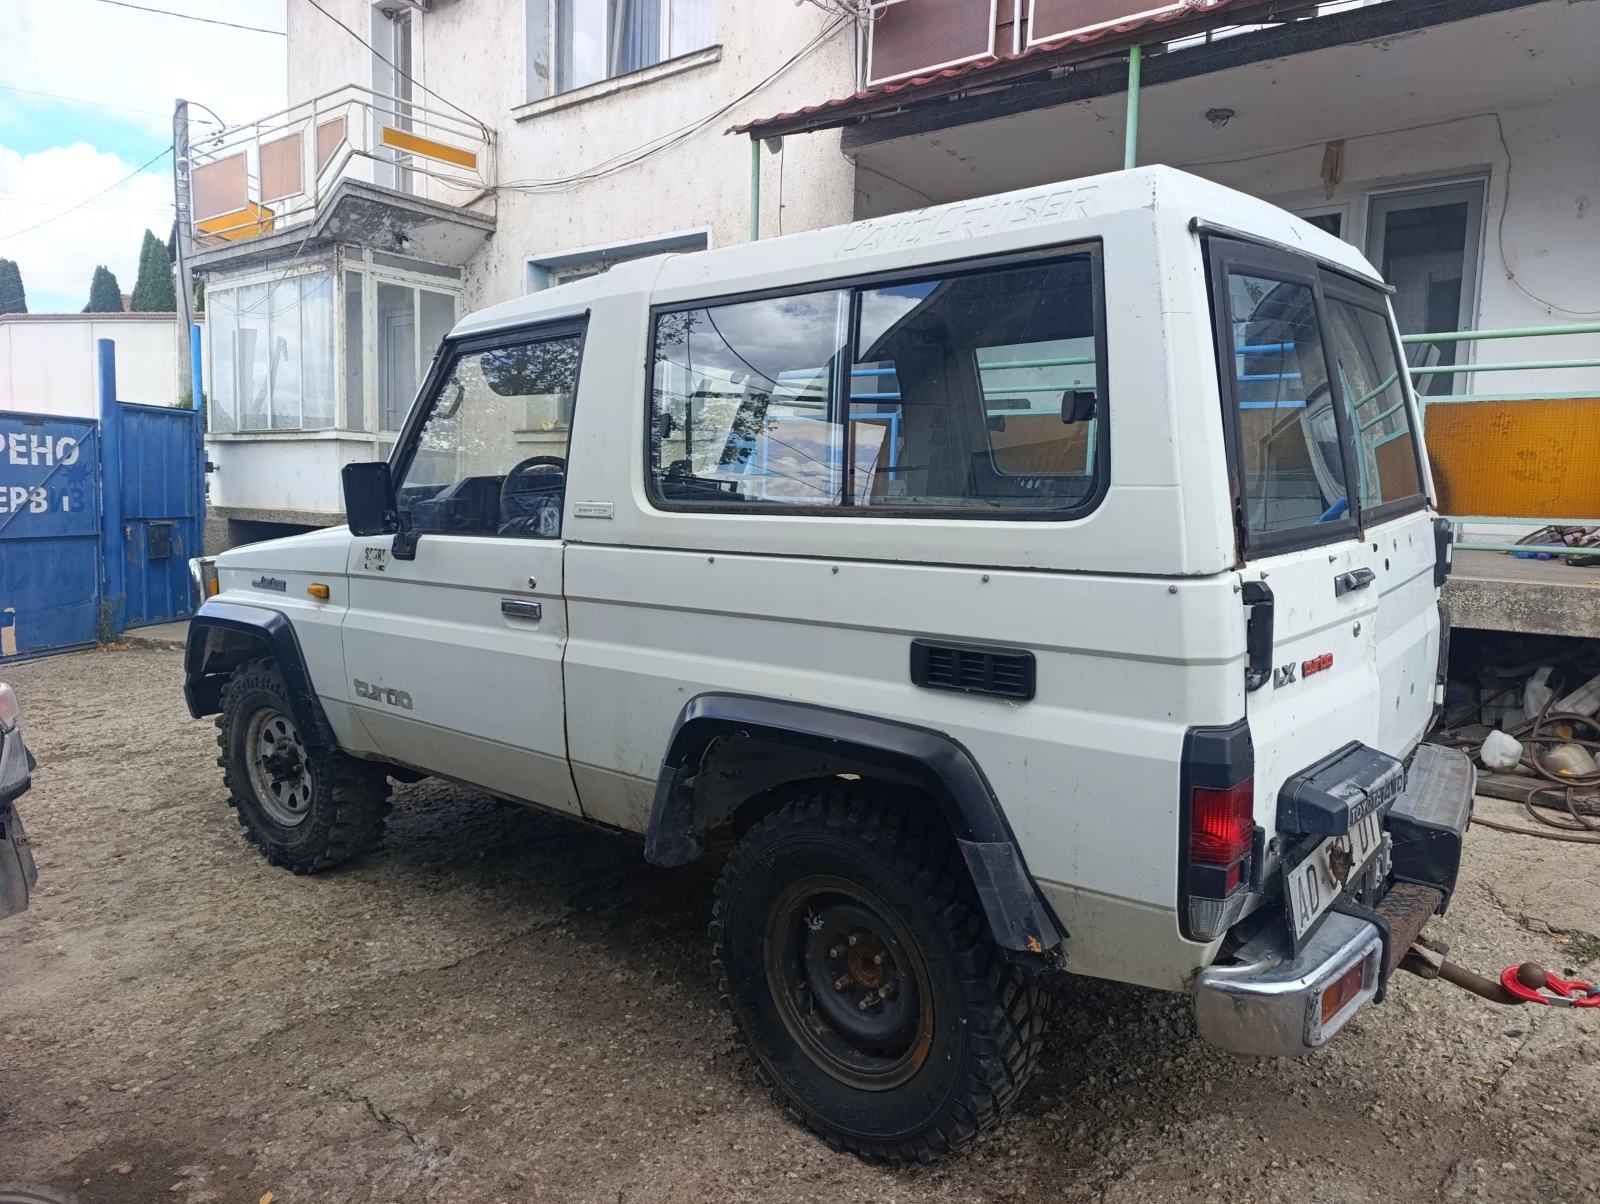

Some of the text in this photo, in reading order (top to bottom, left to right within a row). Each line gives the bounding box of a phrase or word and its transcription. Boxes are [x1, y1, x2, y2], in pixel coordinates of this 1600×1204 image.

[928, 185, 1100, 242] CRUISER
[0, 432, 79, 466] ЕНО
[1274, 662, 1296, 689] LX
[1351, 789, 1382, 824] TOYOTA
[1297, 864, 1319, 928] AD
